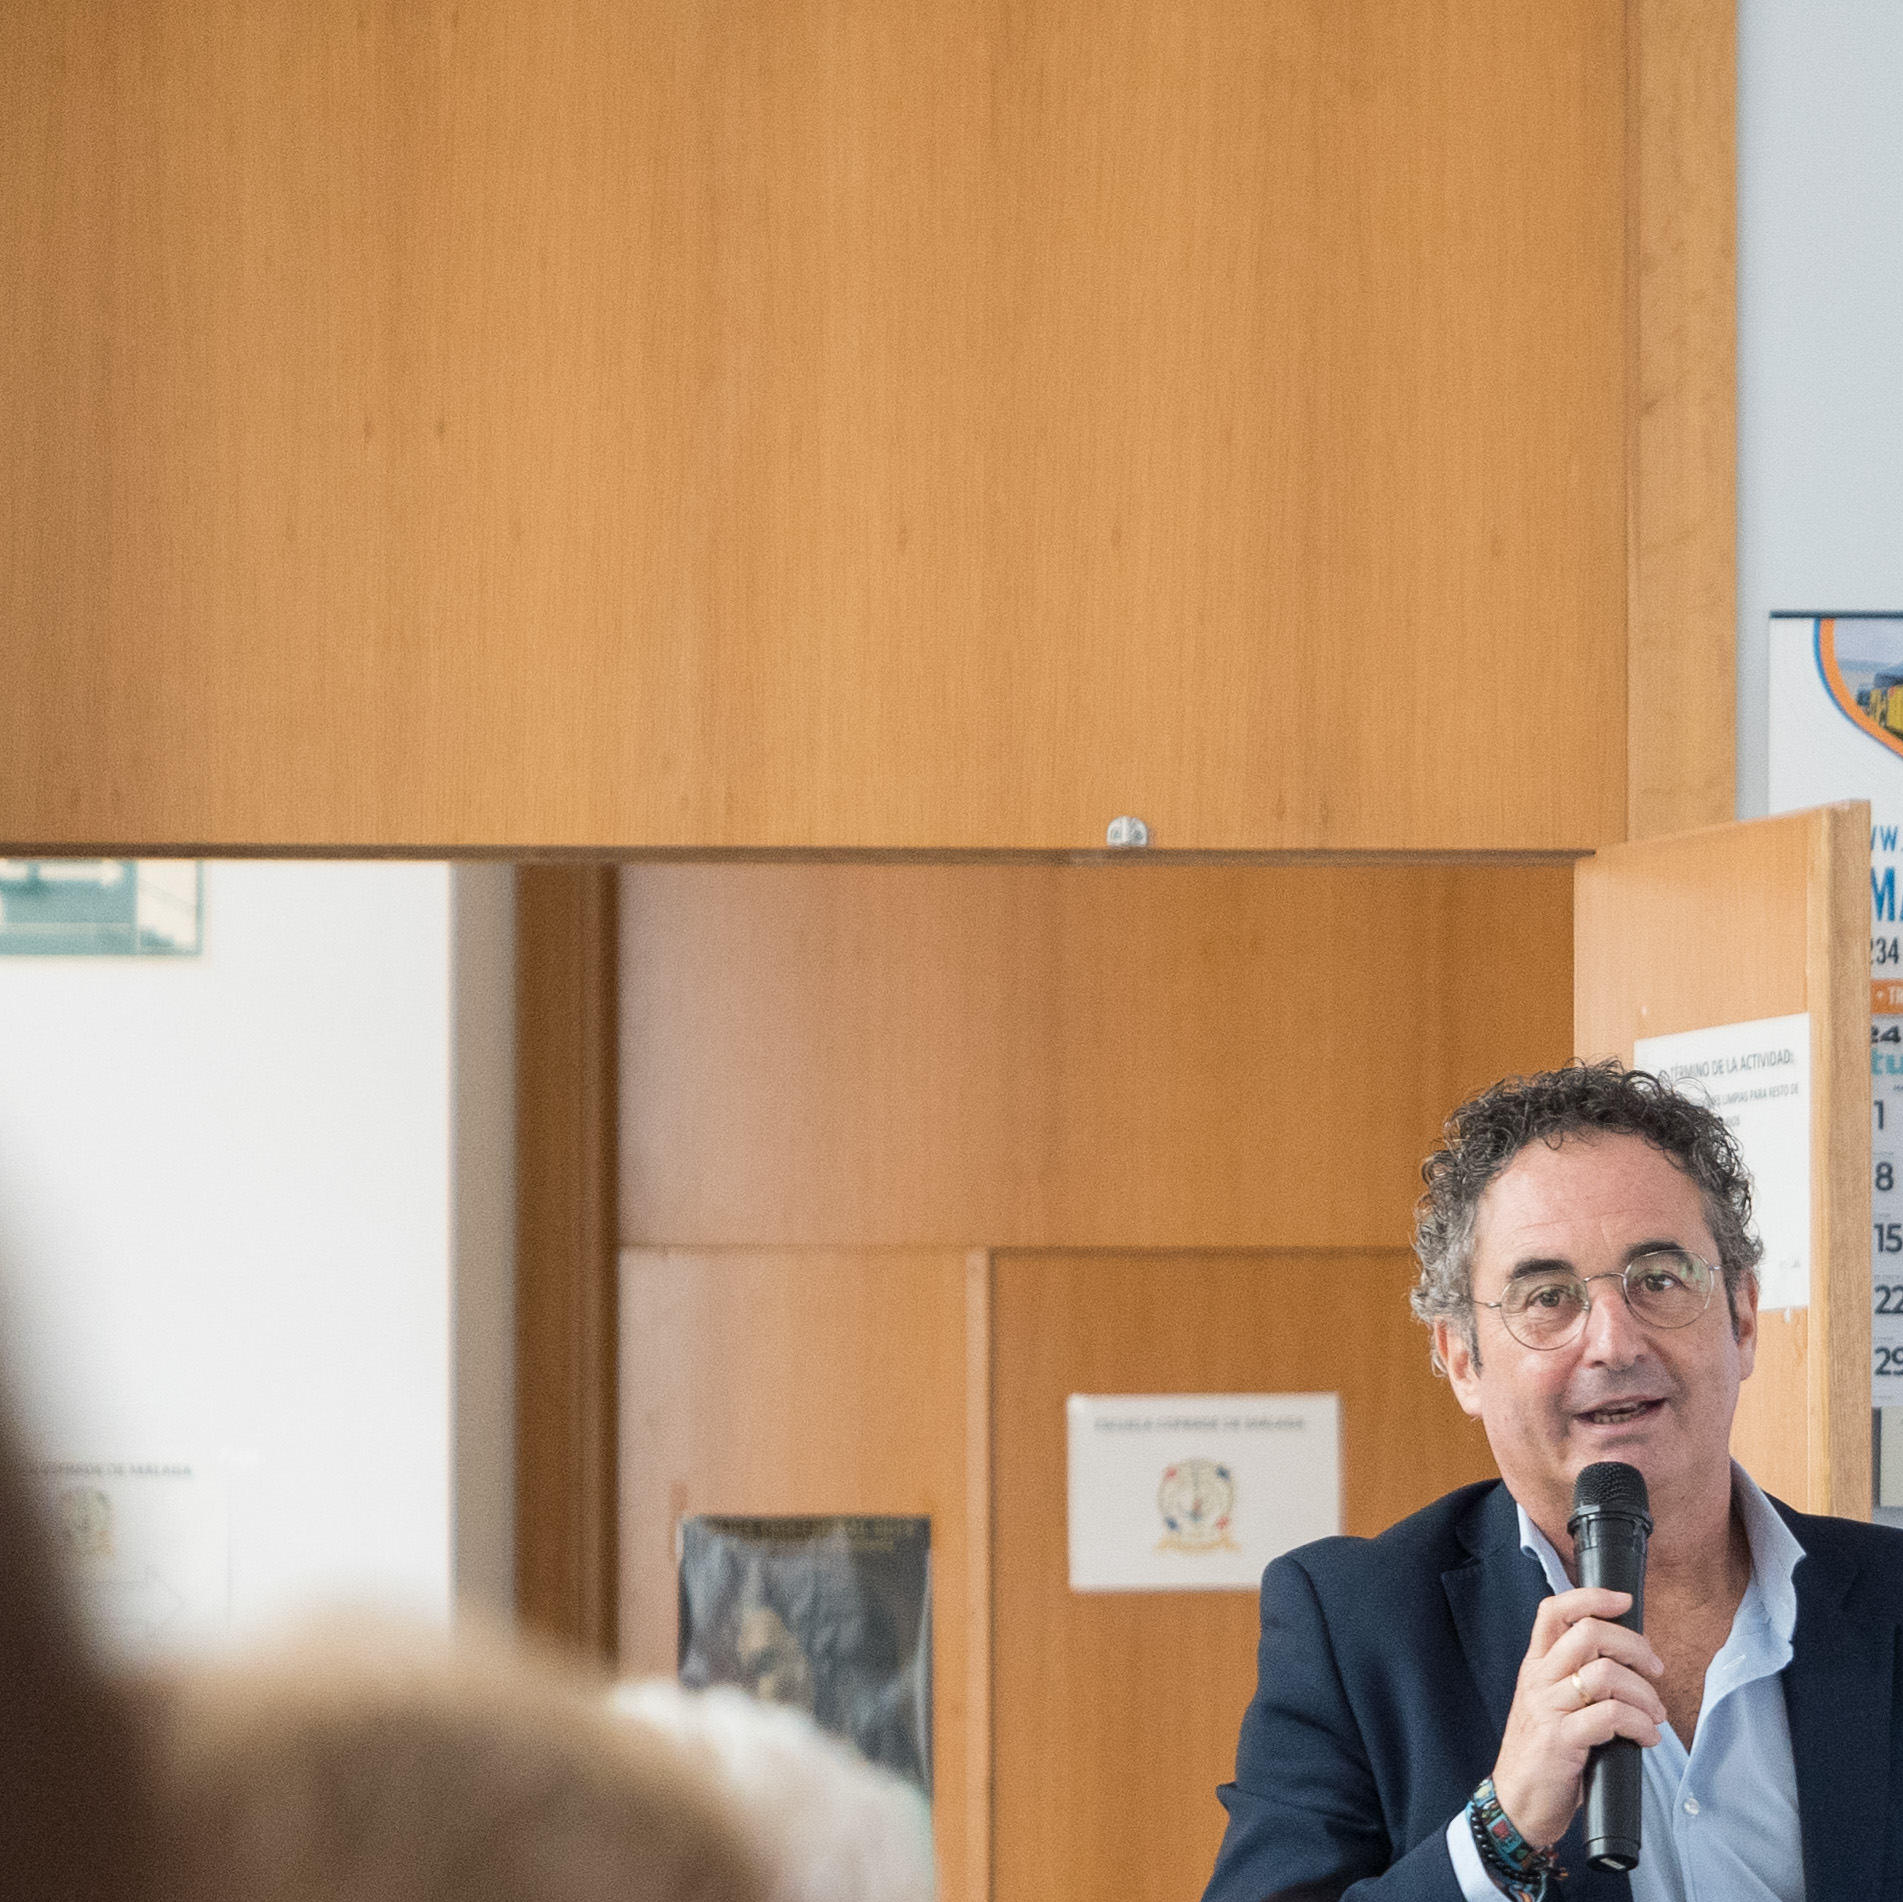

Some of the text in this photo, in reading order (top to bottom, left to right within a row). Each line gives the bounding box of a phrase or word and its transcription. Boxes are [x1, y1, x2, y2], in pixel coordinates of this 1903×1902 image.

[1711, 1058, 1724, 1075] DE
[1726, 1057, 1738, 1073] LA
[1873, 1100, 1885, 1130] 1
[1874, 1162, 1894, 1192] 8
[1873, 1223, 1903, 1253] 15
